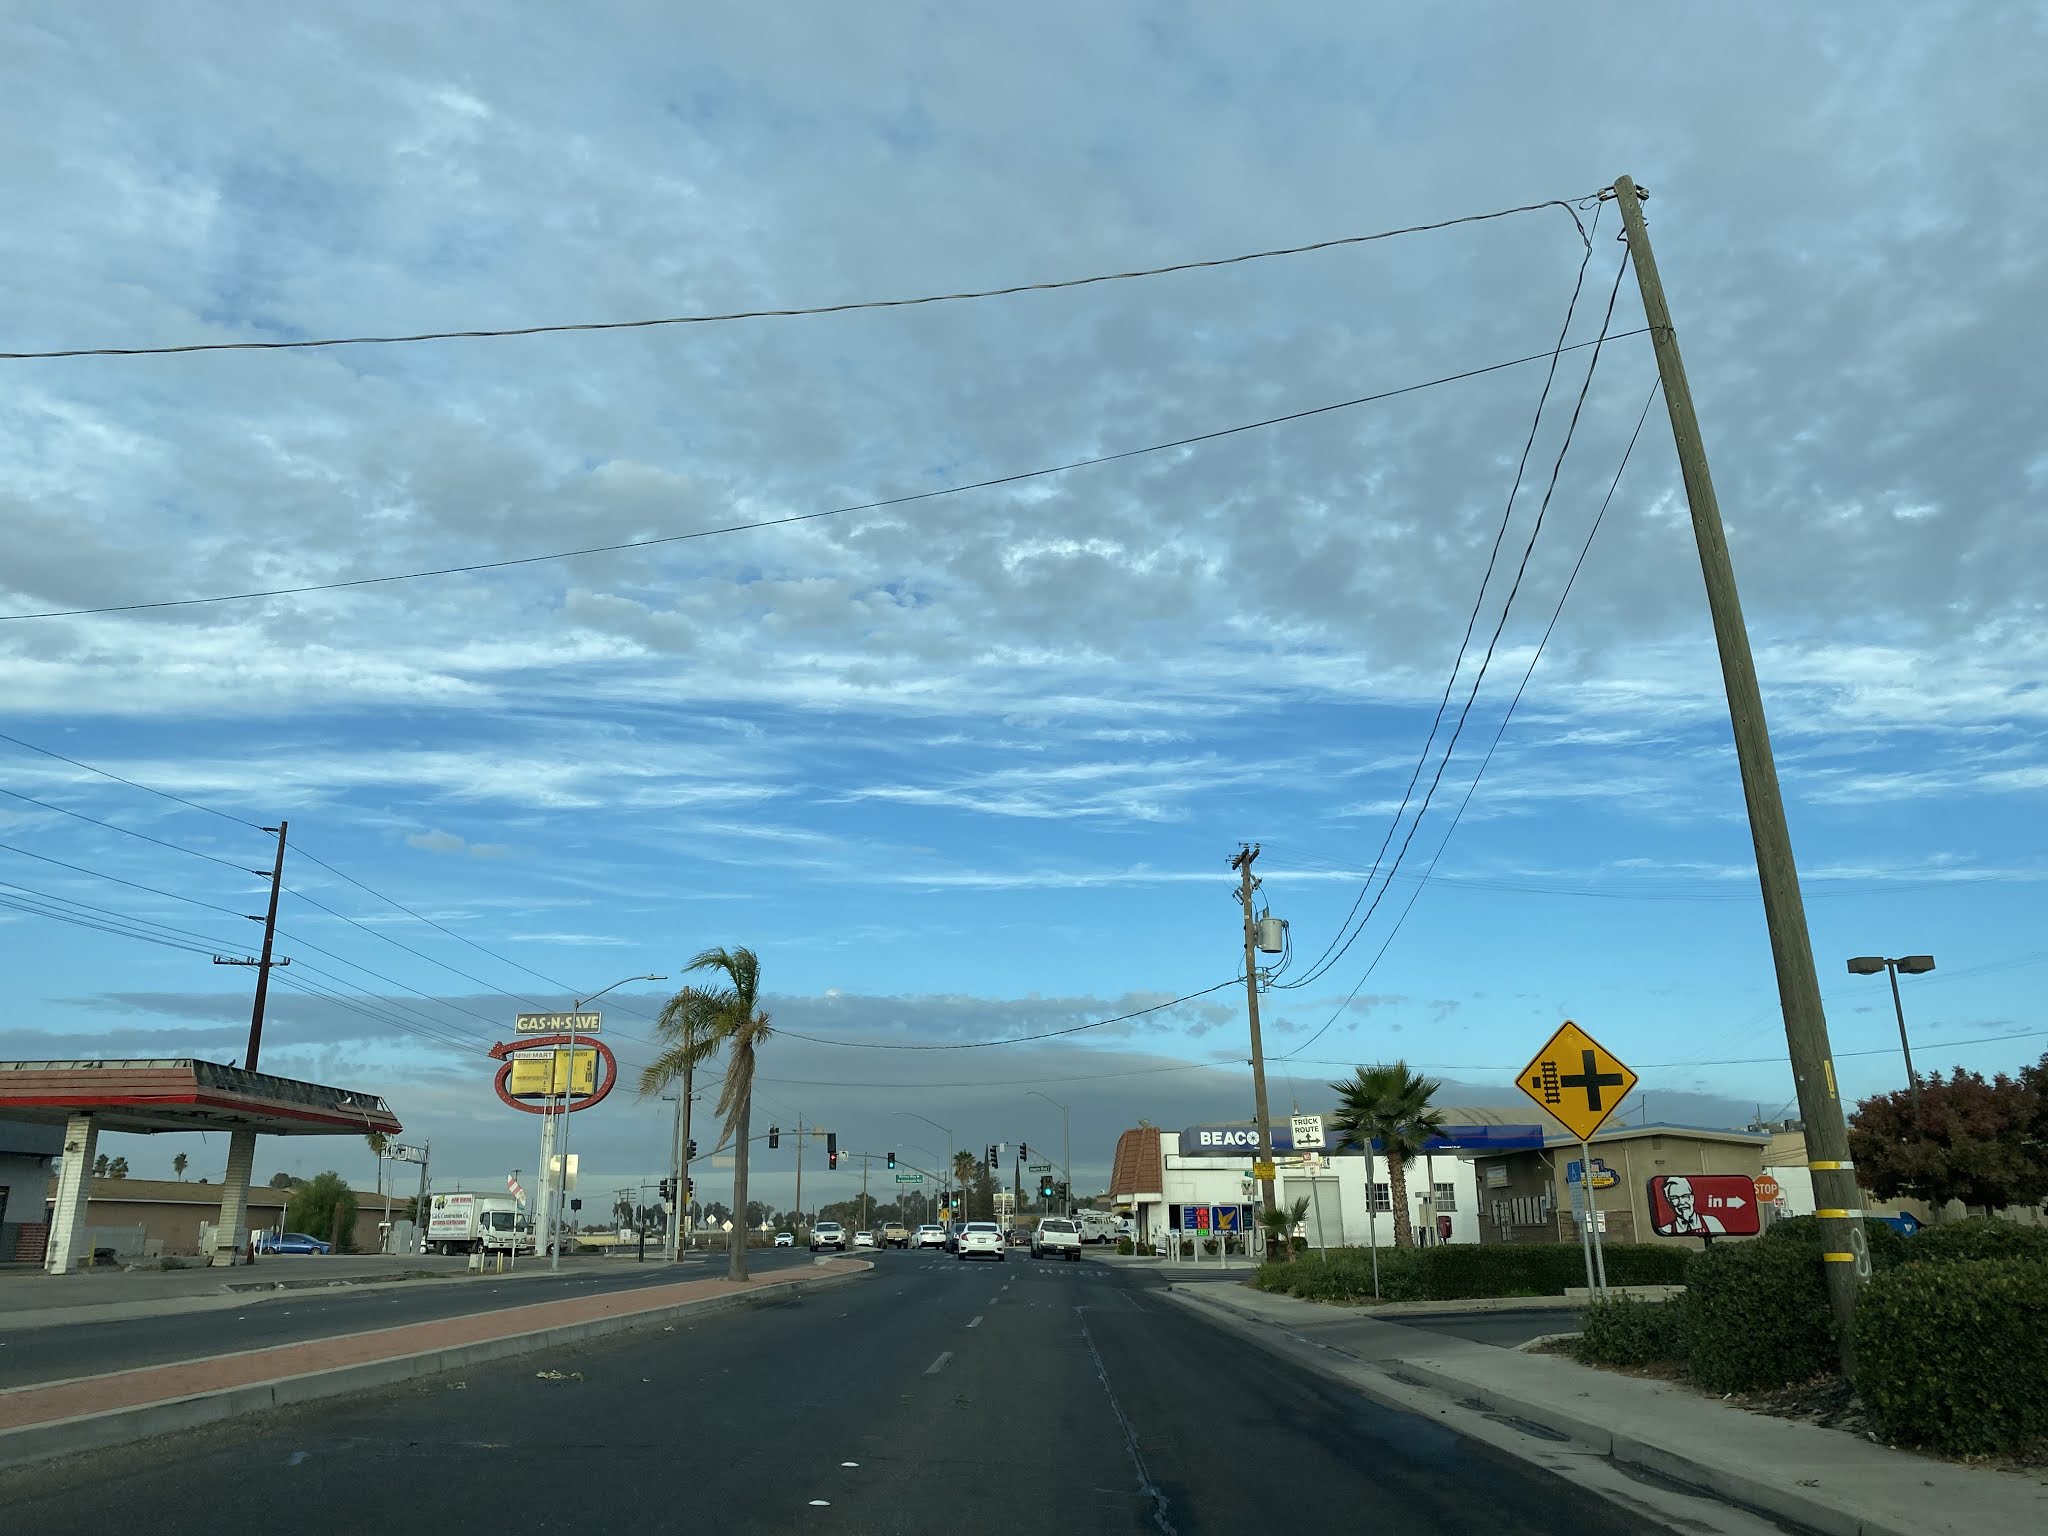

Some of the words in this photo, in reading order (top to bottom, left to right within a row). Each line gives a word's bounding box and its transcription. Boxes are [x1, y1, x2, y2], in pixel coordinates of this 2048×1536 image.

[517, 1015, 599, 1031] GAS-N-SAVE
[1293, 1118, 1318, 1126] TRUCK
[1295, 1126, 1320, 1134] ROUTE
[1200, 1131, 1272, 1145] BEACO
[1754, 1183, 1778, 1195] STOP
[1708, 1194, 1722, 1208] in
